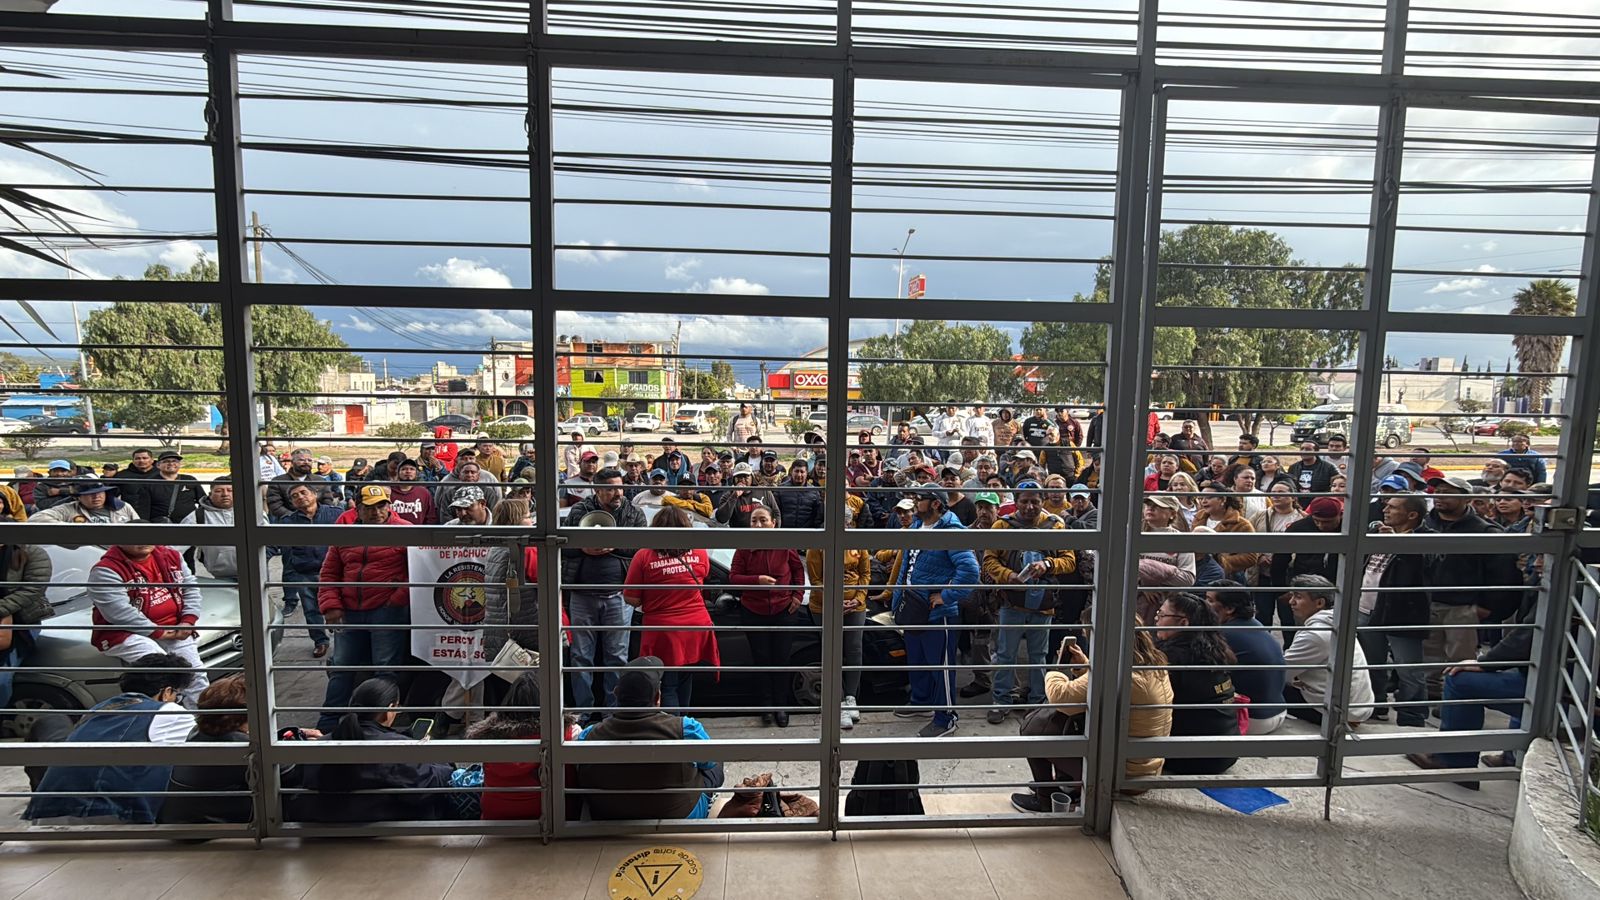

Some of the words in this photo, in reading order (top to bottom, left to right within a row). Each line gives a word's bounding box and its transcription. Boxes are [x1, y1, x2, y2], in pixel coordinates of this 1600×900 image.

[795, 374, 828, 386] OXXO
[620, 384, 660, 392] ABOGADOS
[440, 550, 451, 559] DE
[453, 549, 488, 559] PACHUC
[686, 556, 700, 564] BAJO
[445, 570, 453, 579] LA
[440, 636, 475, 645] PERCY
[433, 648, 467, 659] ESTÁS
[474, 650, 488, 659] SO
[615, 850, 651, 878] distancia
[677, 852, 698, 875] Guarde
